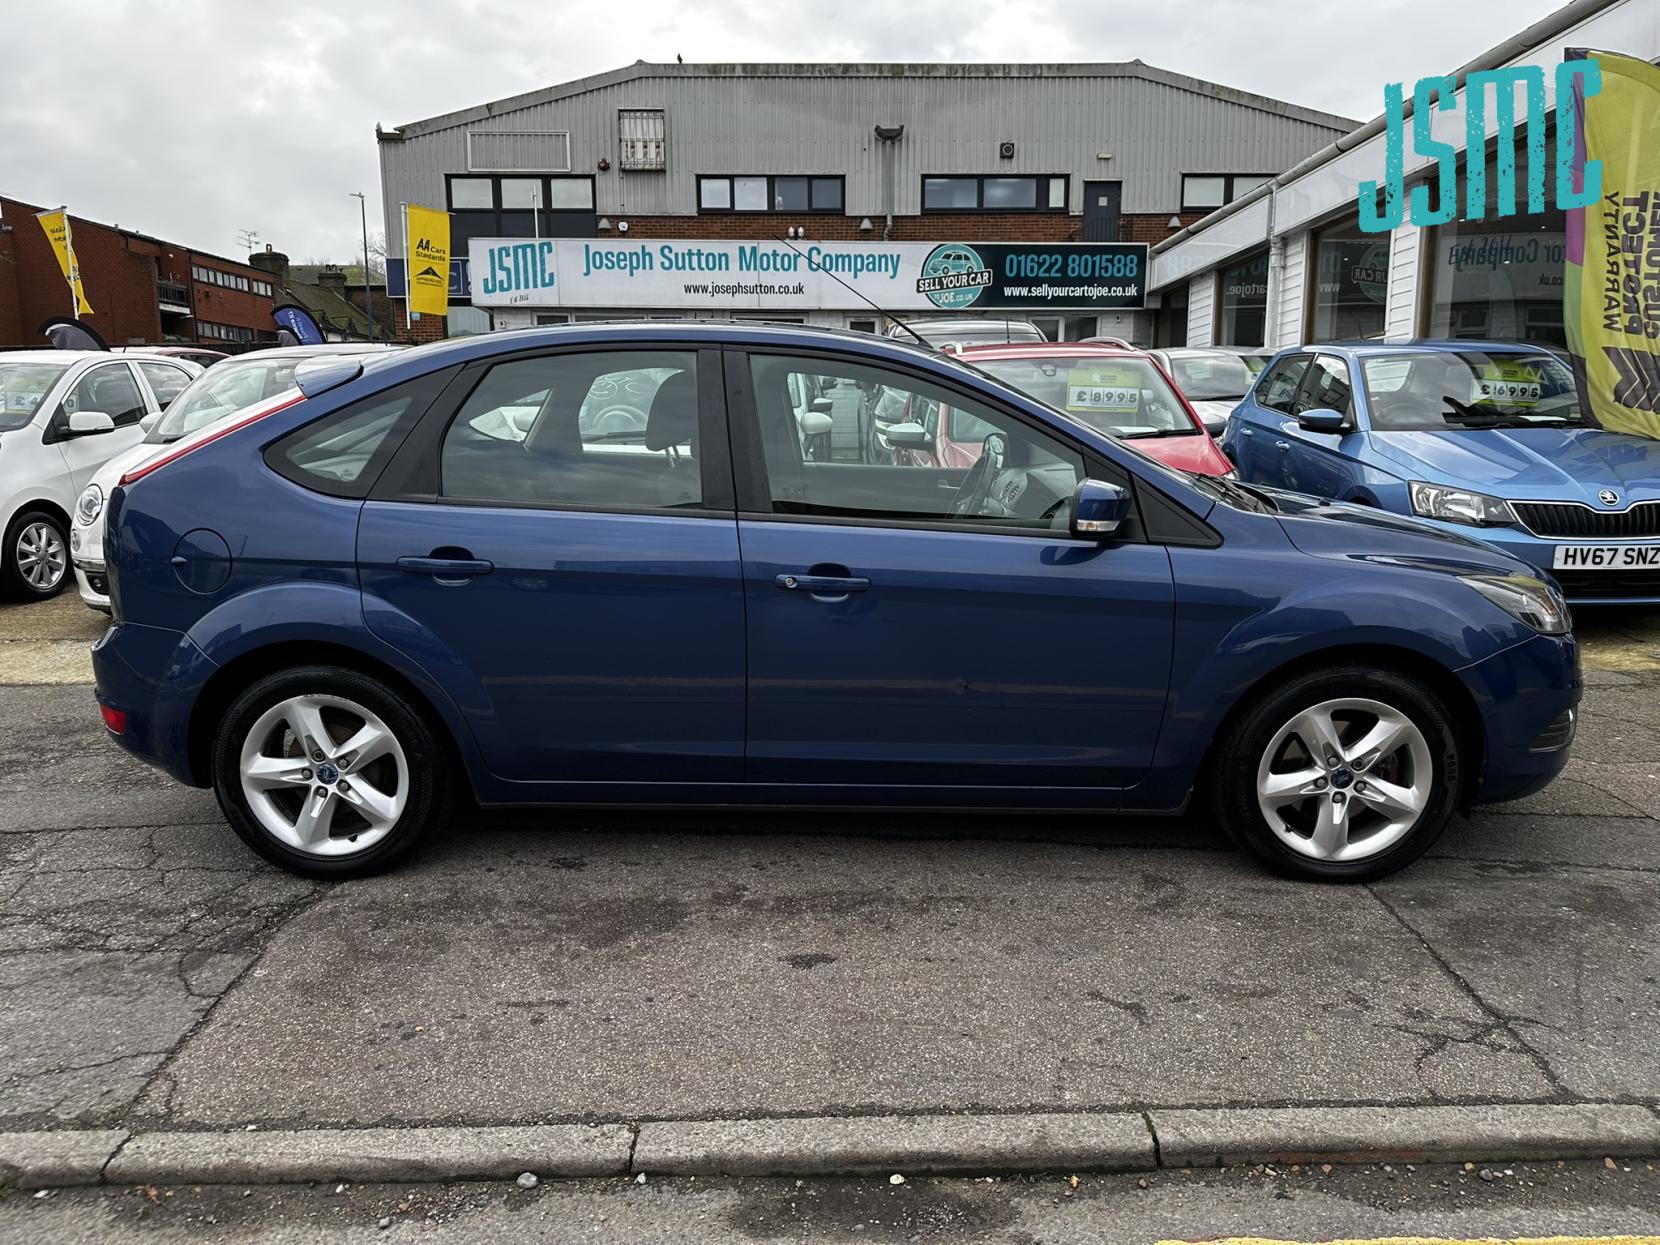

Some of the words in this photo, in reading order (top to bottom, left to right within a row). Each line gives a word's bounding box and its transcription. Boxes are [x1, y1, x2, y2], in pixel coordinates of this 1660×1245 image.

[415, 250, 446, 262] Standards
[416, 238, 431, 252] AA
[430, 247, 446, 255] Cars
[482, 241, 555, 294] JSMC
[583, 243, 654, 277] Joseph
[660, 244, 730, 271] Sutton
[738, 245, 801, 272] Motor
[807, 246, 901, 279] Company
[1005, 254, 1063, 278] 01622
[1067, 254, 1138, 278] 801588
[683, 281, 805, 298] www.josephsutton.co.uk
[918, 278, 941, 292] SELL
[941, 274, 968, 289] YOUR
[968, 271, 989, 285] CAR
[1003, 283, 1138, 300] www.sellyourcartojoe.co.uk
[1563, 547, 1619, 566] HV67
[1623, 547, 1660, 566] SNZ
